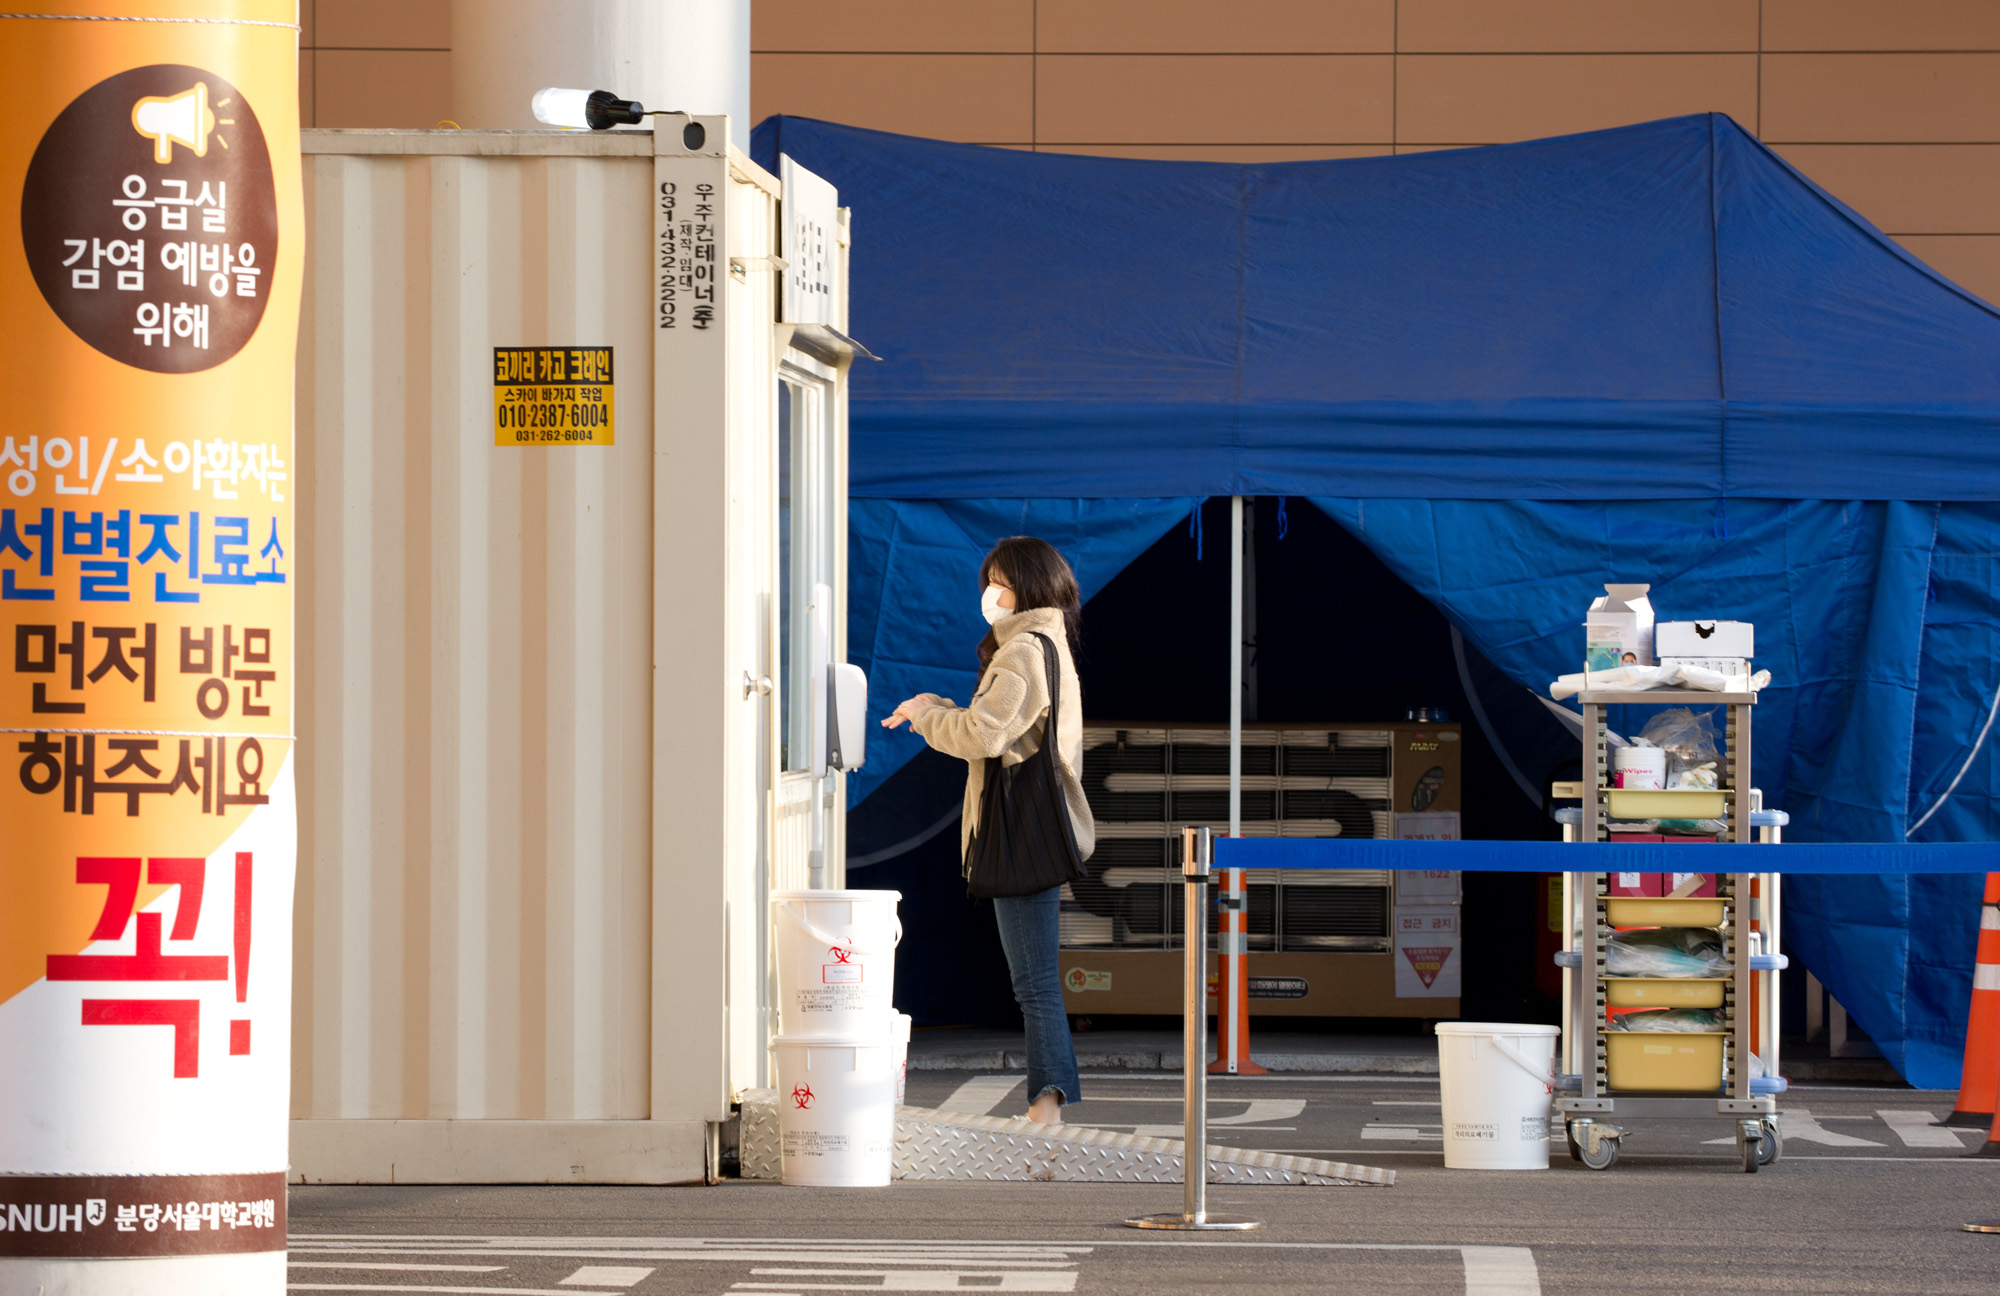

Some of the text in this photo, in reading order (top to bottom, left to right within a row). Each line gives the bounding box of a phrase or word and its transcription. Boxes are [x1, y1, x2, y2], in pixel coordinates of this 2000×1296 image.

[112, 174, 227, 233] 응급실
[61, 238, 262, 297] 감염 예방을
[693, 183, 714, 330] 우주컨테이너(주)
[133, 302, 209, 349] 위해
[497, 350, 609, 382] 코끼리 카고 크레인
[504, 388, 602, 402] 스카이 바가지 작업
[0, 435, 287, 502] 성인/소아환자는
[0, 507, 286, 603] 선별진료소
[15, 621, 276, 720] 먼저 방문
[18, 731, 269, 817] 해주세요
[1403, 918, 1452, 930] 접근 금지
[46, 851, 253, 1078] 꼭!
[114, 1198, 276, 1233] 분당서울대학교병원
